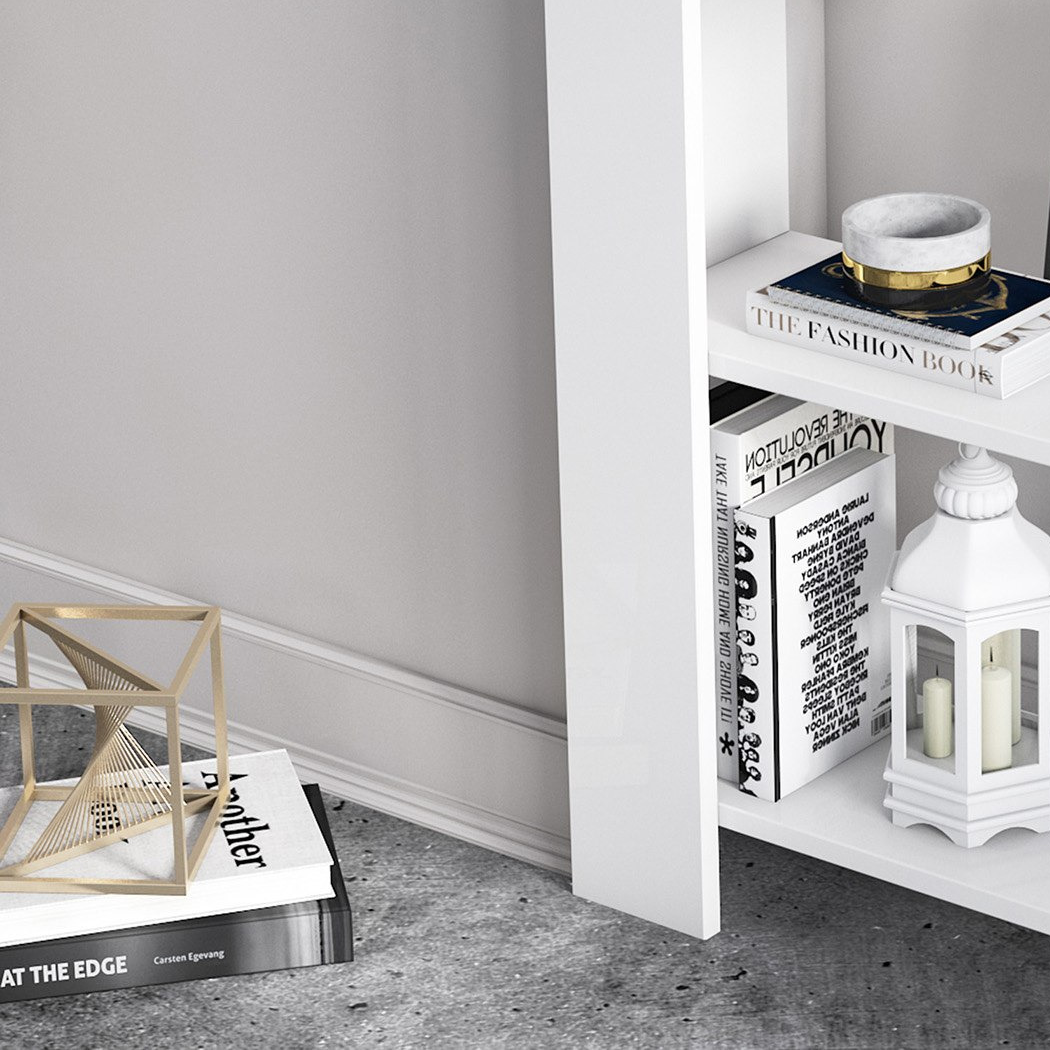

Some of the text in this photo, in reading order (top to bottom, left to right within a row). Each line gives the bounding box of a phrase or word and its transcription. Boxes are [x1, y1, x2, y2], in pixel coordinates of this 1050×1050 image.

[751, 306, 801, 336] THE
[807, 321, 914, 364] FASHION
[0, 955, 128, 988] AT THE EDGE
[153, 950, 225, 965] Carsten Egevang
